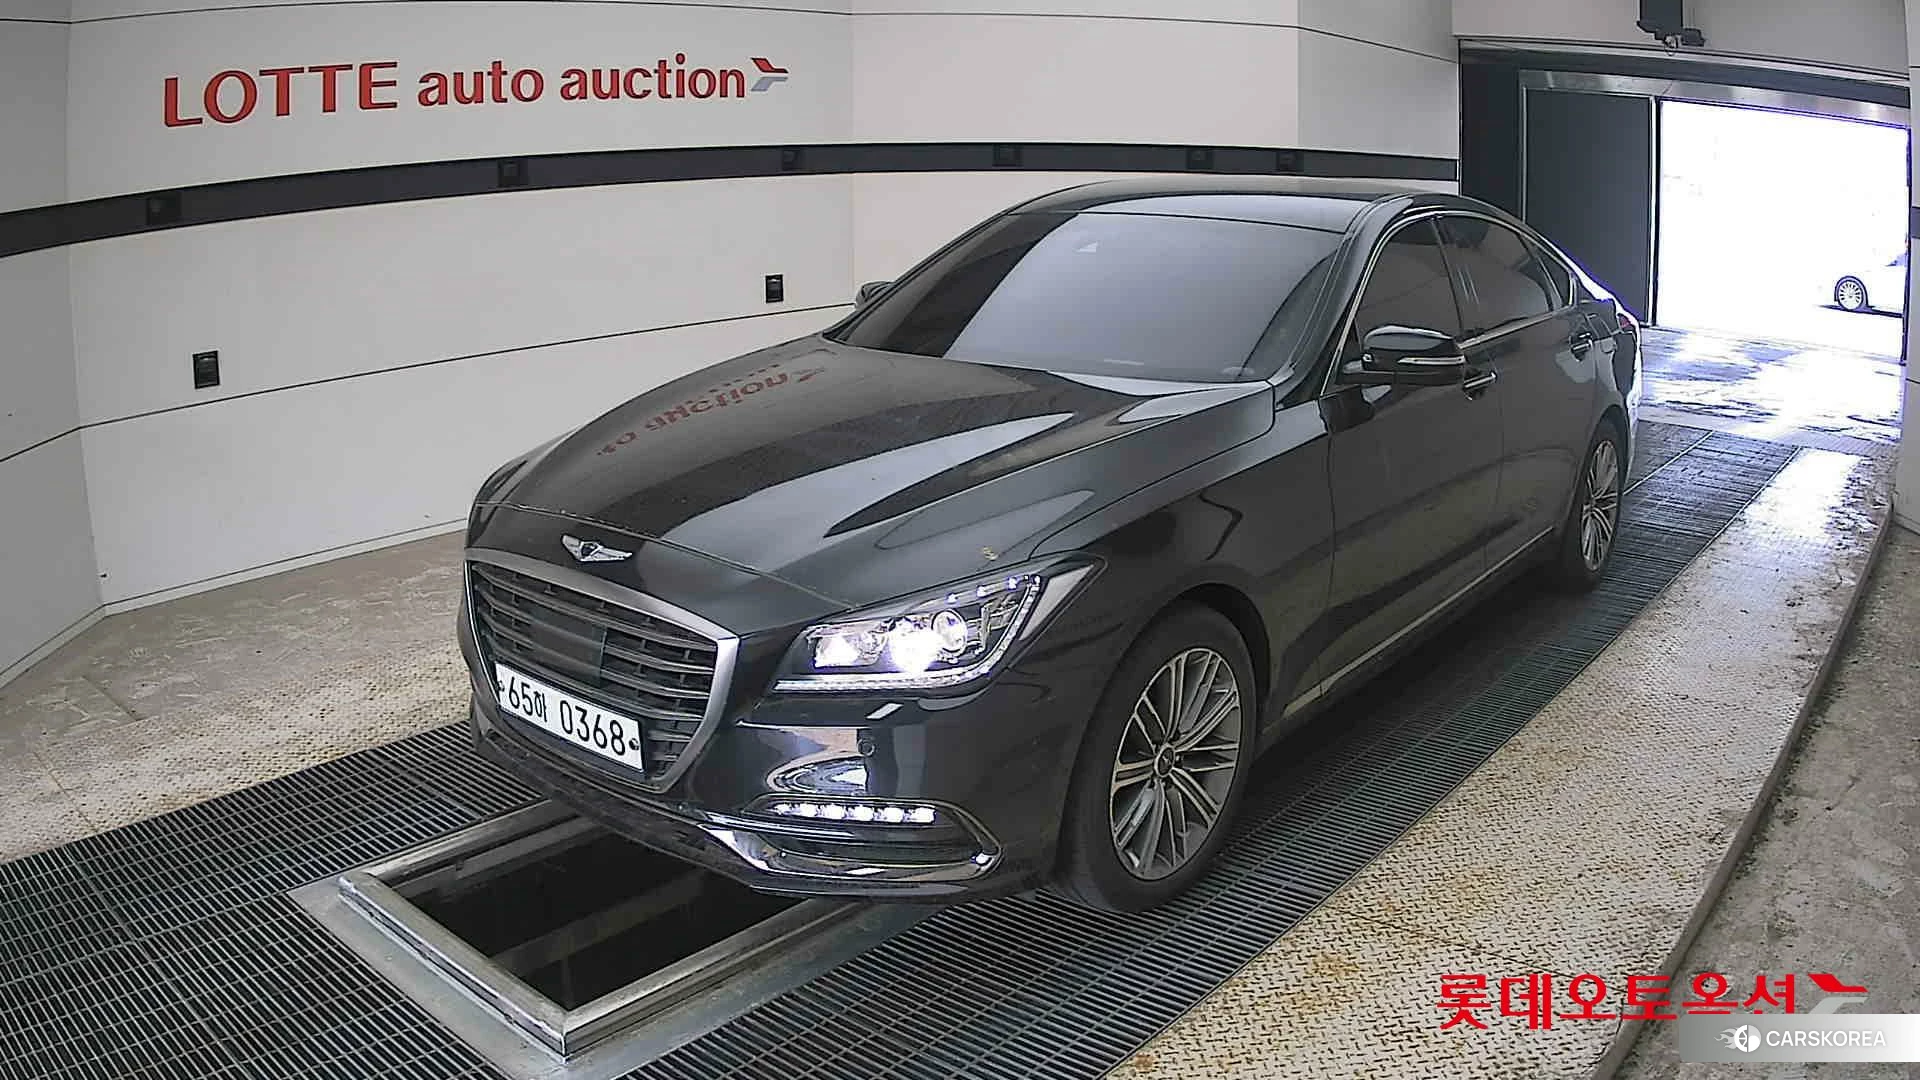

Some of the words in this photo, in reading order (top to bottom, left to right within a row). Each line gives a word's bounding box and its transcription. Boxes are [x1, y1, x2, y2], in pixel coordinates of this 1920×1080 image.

[163, 61, 399, 128] LOTTE
[417, 60, 545, 107] auto
[559, 53, 746, 101] auction
[509, 677, 547, 722] 65하
[560, 700, 626, 756] 0368
